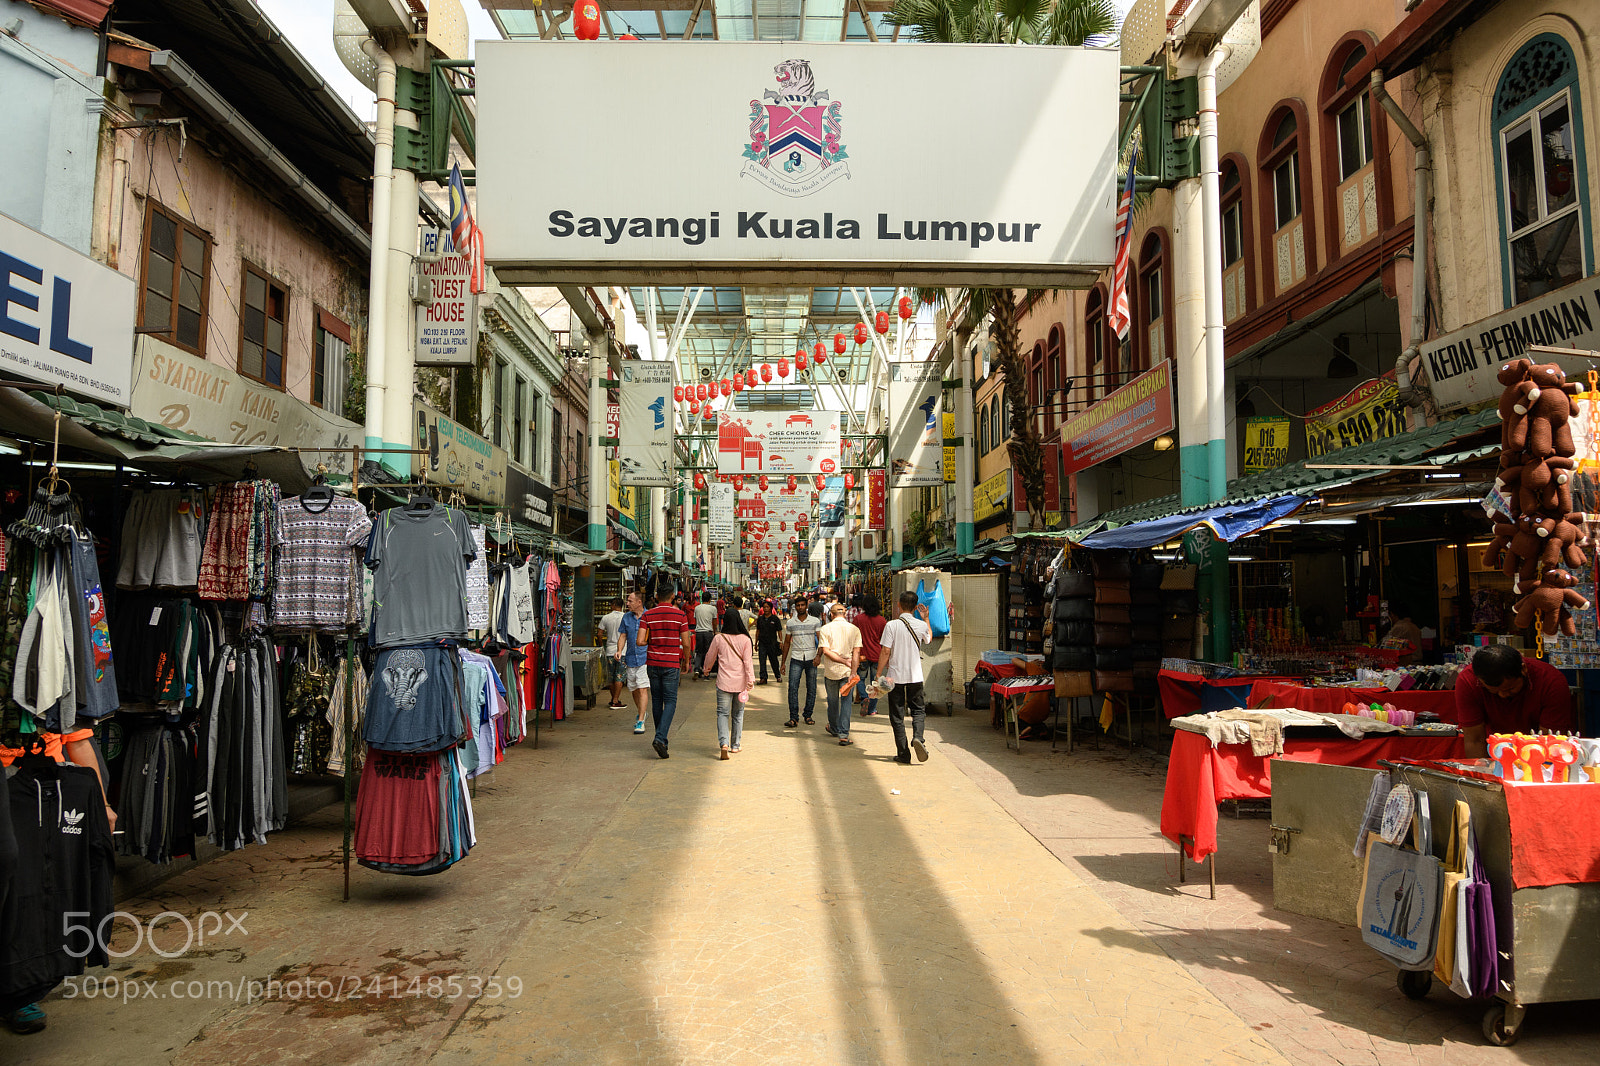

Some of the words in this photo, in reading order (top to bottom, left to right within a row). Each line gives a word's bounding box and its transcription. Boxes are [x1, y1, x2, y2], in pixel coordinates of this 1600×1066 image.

[547, 209, 720, 246] Sayangi
[736, 211, 861, 240] Kuala
[876, 213, 1042, 249] Lumpur
[426, 302, 465, 322] HOUSE
[1427, 338, 1479, 383] KEDAI
[1479, 295, 1594, 366] PERMAINAN
[150, 354, 230, 404] SYARIKAT
[1138, 366, 1167, 400] TERPAKAI
[1133, 396, 1156, 420] BUNDLE
[1260, 428, 1275, 447] 016
[374, 765, 430, 780] WARS
[62, 825, 82, 835] adidas
